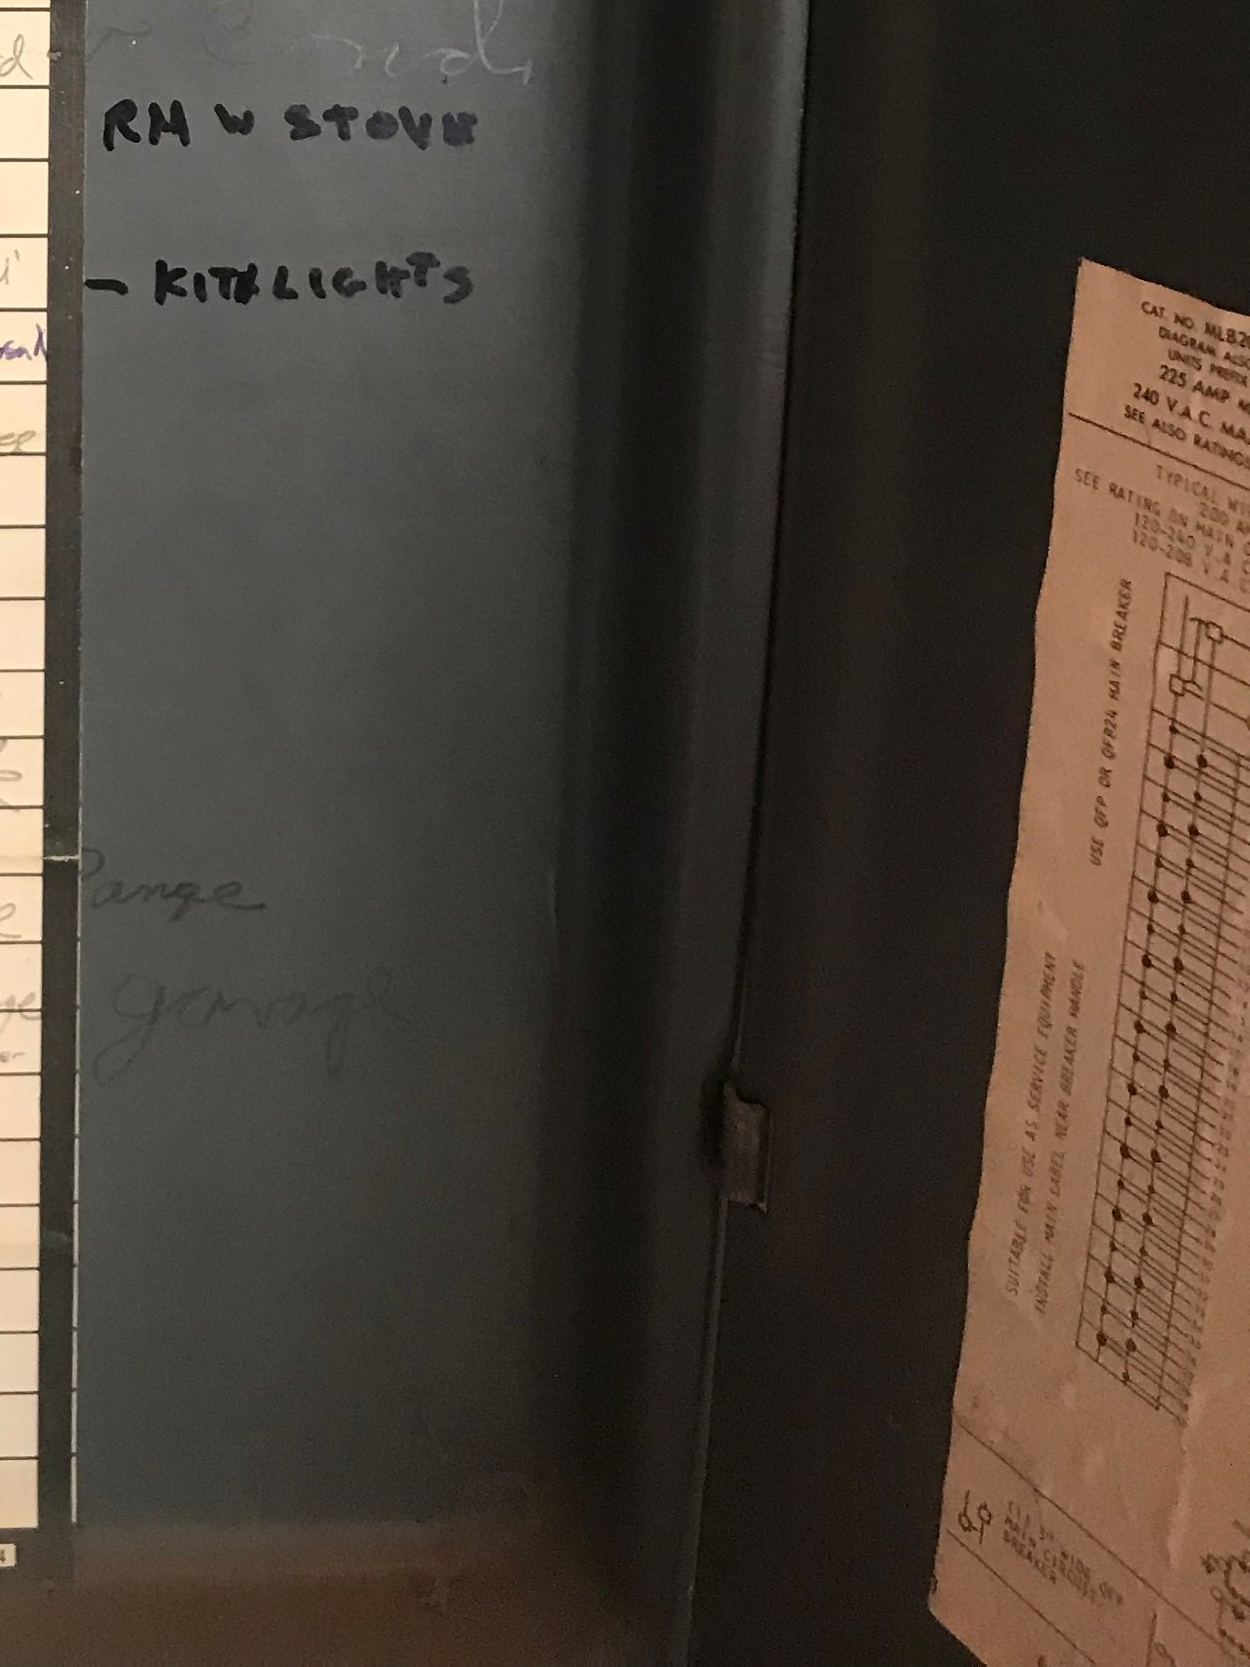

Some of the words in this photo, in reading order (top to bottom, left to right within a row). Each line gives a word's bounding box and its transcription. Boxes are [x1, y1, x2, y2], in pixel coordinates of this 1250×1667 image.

[213, 102, 256, 136] W
[272, 250, 475, 304] LIGHTS
[1132, 381, 1161, 407] 240
[1159, 364, 1188, 389] 225
[1192, 380, 1231, 404] AMP
[1123, 404, 1148, 426] SEE
[1151, 417, 1189, 443] ALSO
[1073, 467, 1101, 492] SEE
[1108, 577, 1133, 654] BREAKER
[1107, 657, 1122, 702] MAIN
[1089, 836, 1105, 867] USE
[1026, 1044, 1050, 1114] SERVICE
[1025, 1119, 1039, 1143] AS
[1021, 1145, 1037, 1178] USE
[1004, 1217, 1029, 1297] SUITABLE
